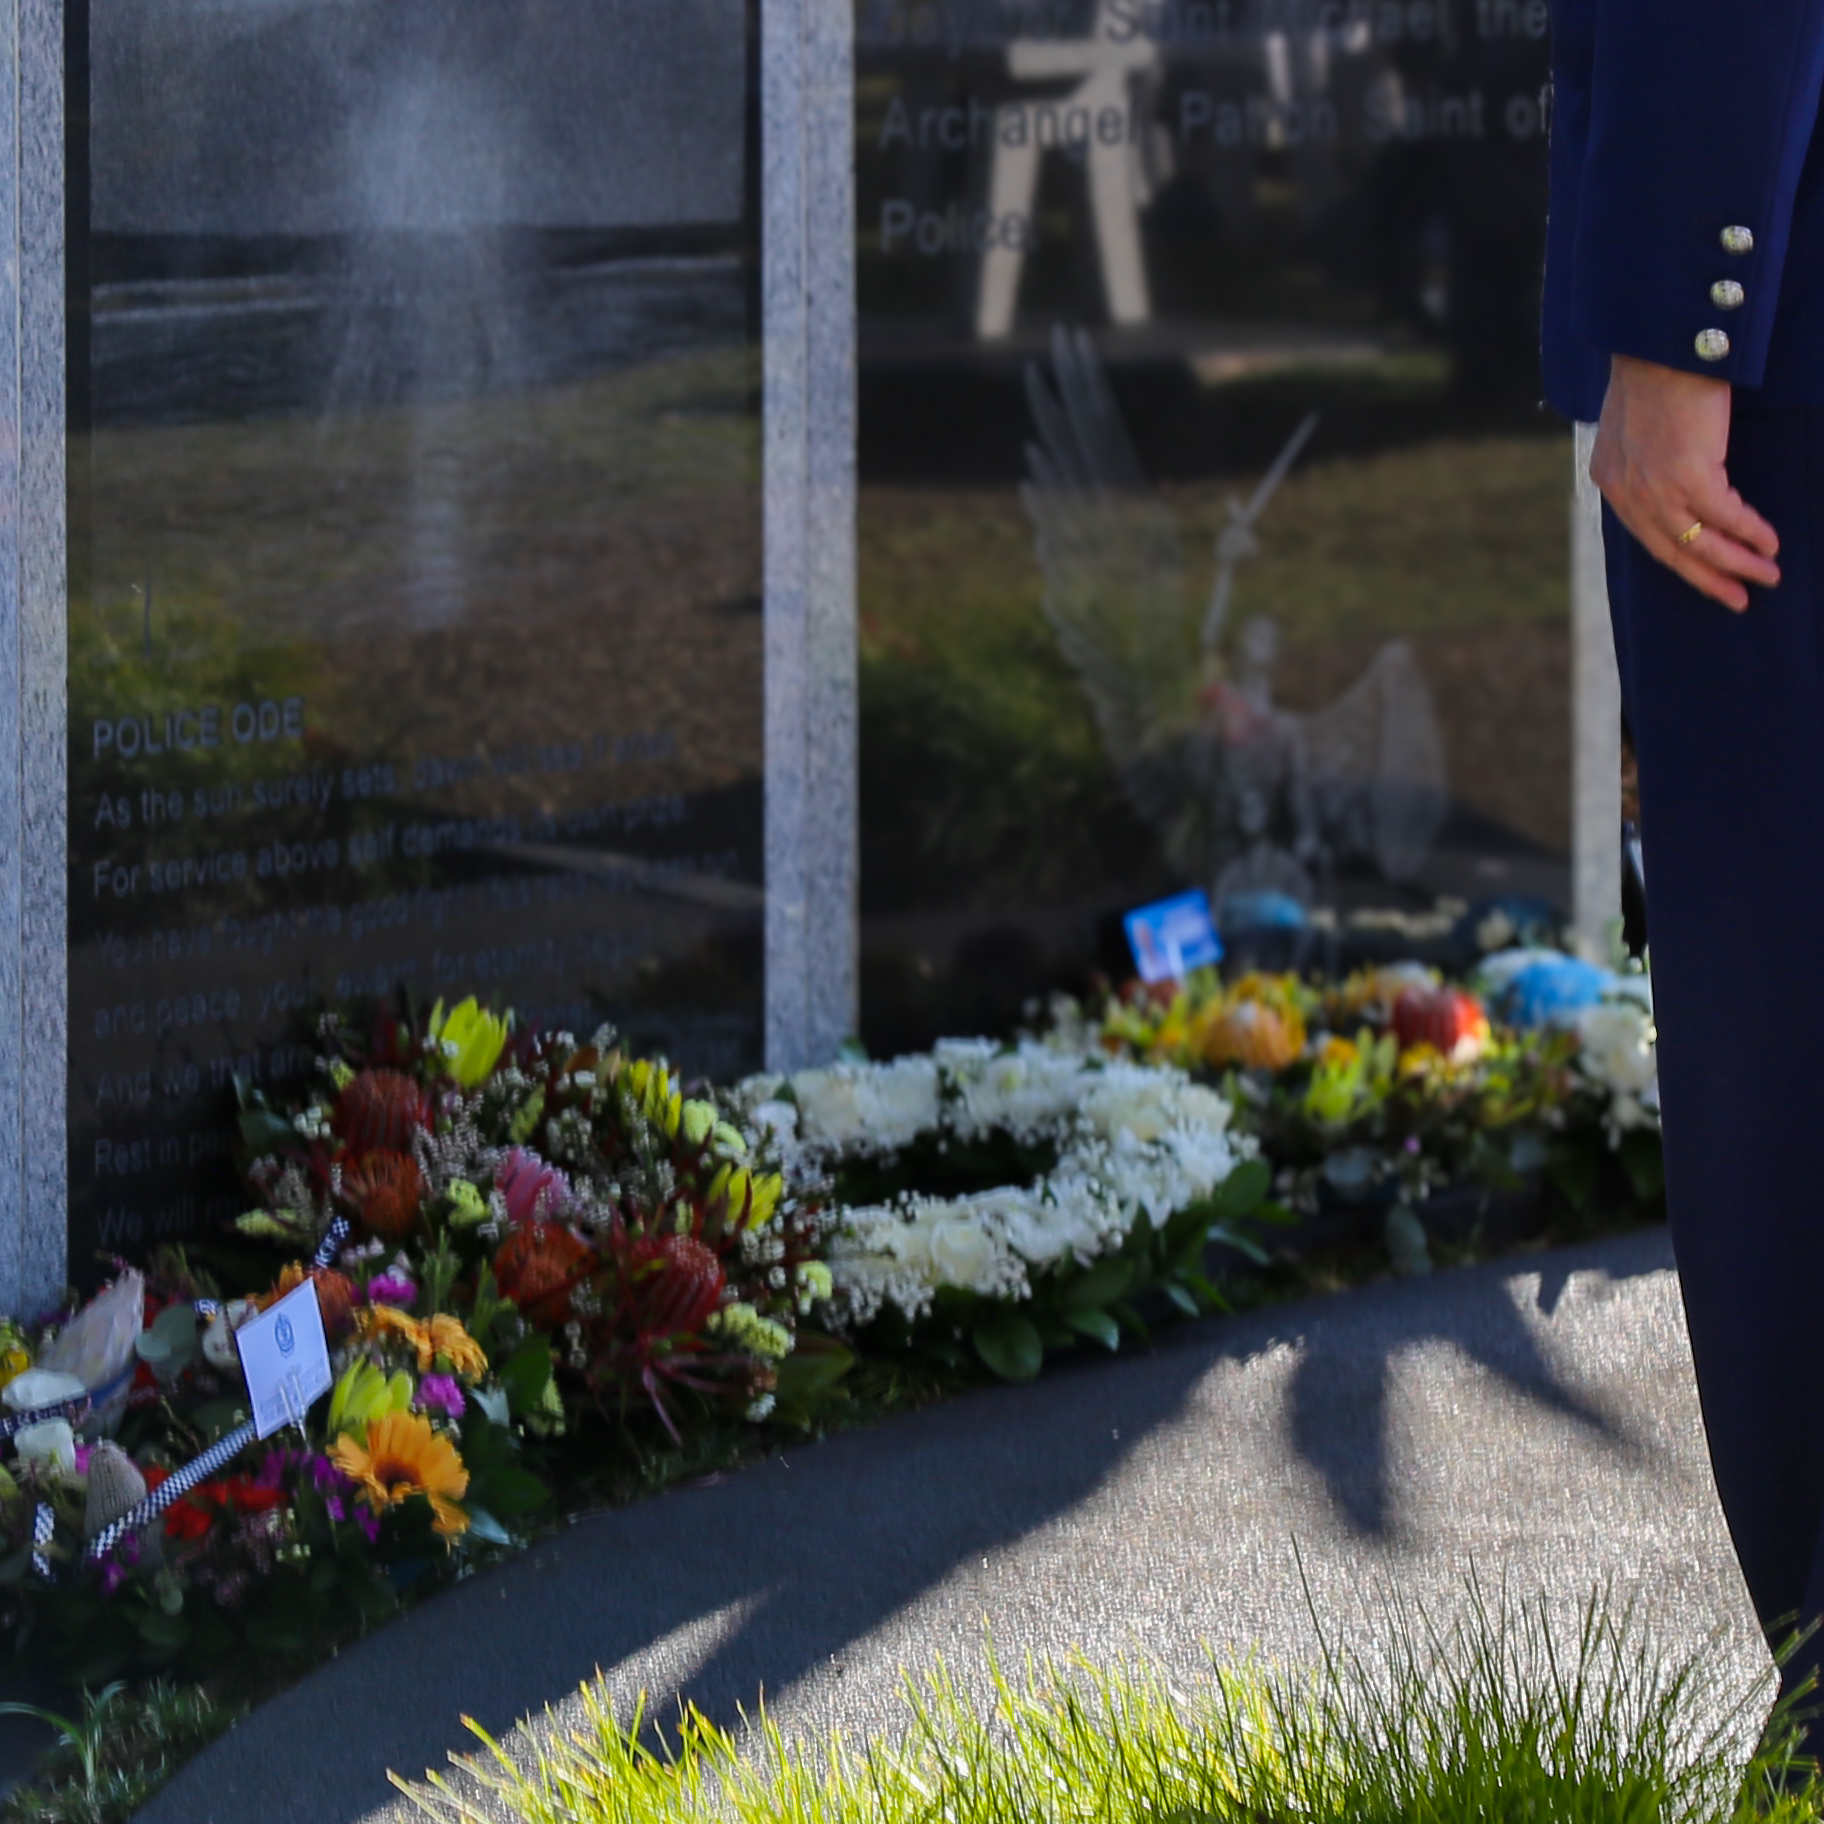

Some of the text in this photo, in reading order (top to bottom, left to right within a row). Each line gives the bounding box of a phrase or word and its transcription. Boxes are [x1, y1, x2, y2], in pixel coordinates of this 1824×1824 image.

[1505, 83, 1551, 139] of
[94, 697, 302, 758] POLICE ODE
[95, 792, 131, 829] As
[141, 787, 184, 824] the
[194, 781, 243, 818] sun
[253, 766, 333, 814] surely
[94, 858, 140, 897] For
[148, 850, 247, 894] service
[256, 838, 339, 878] above
[347, 821, 396, 870] self
[96, 930, 143, 967] You
[151, 921, 211, 961] have
[95, 998, 147, 1040] and
[95, 1064, 151, 1109] And
[164, 1062, 201, 1097] we
[95, 1137, 152, 1176] Rest
[158, 1132, 182, 1166] in
[97, 1207, 143, 1244] We
[152, 1195, 195, 1236] will
